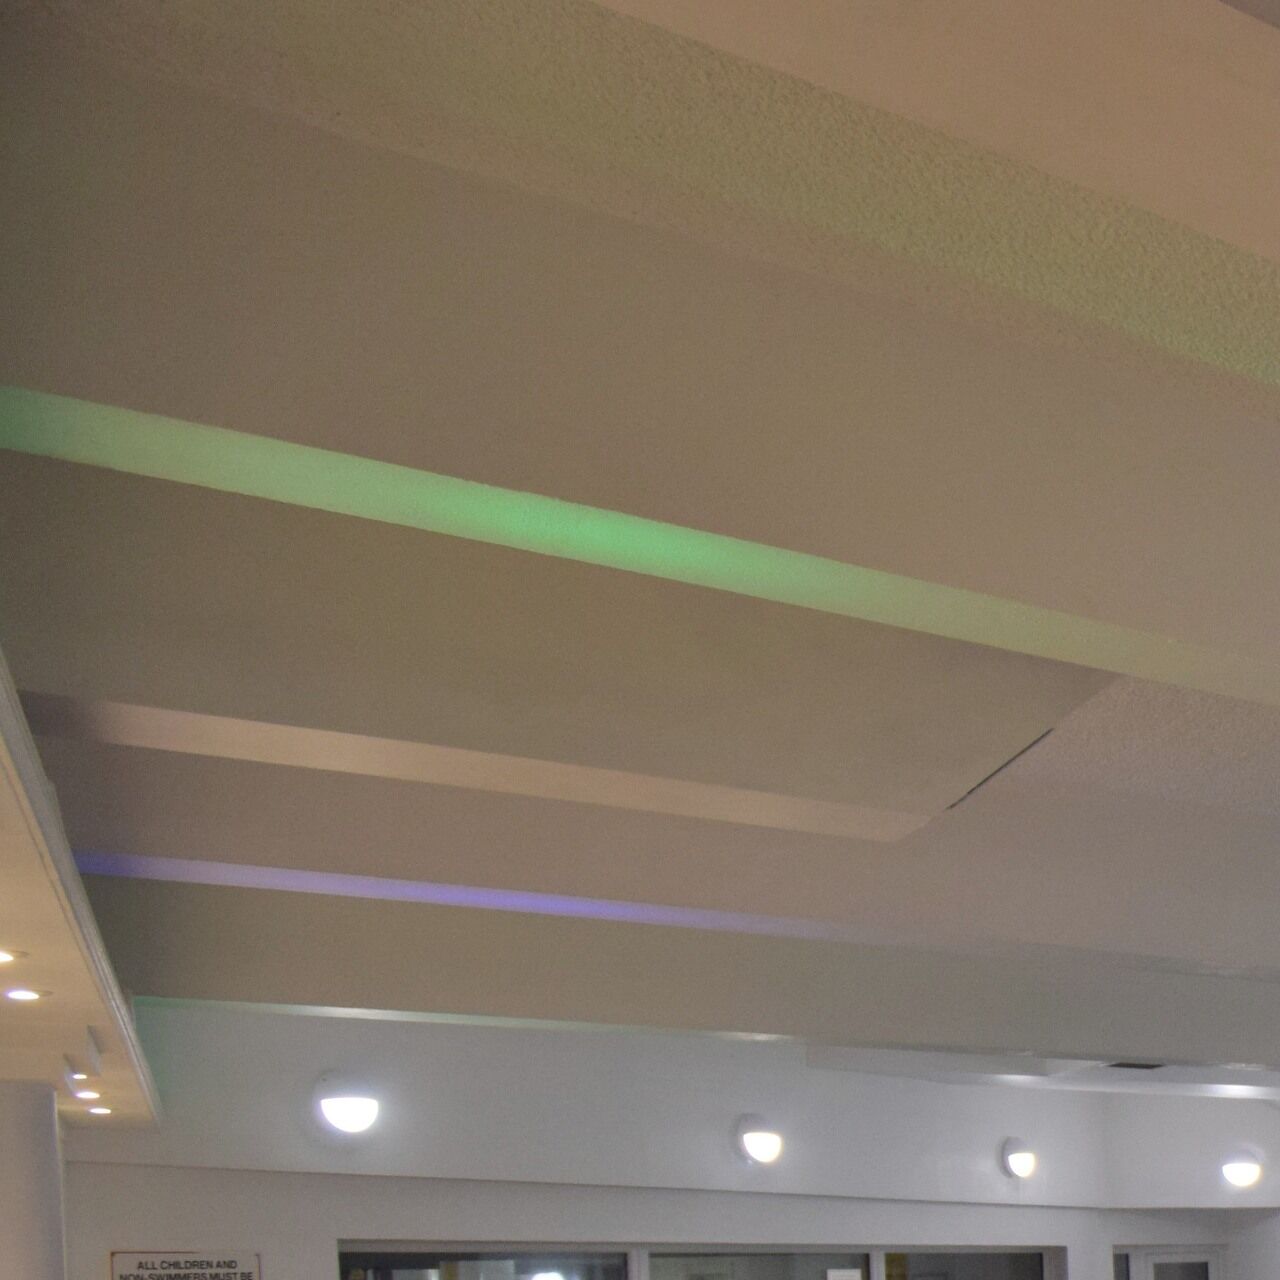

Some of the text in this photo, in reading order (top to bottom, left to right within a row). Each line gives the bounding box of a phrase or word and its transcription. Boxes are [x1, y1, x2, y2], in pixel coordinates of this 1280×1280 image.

[138, 1260, 237, 1271] ALL CHILDREN AND
[240, 1272, 253, 1280] BE
